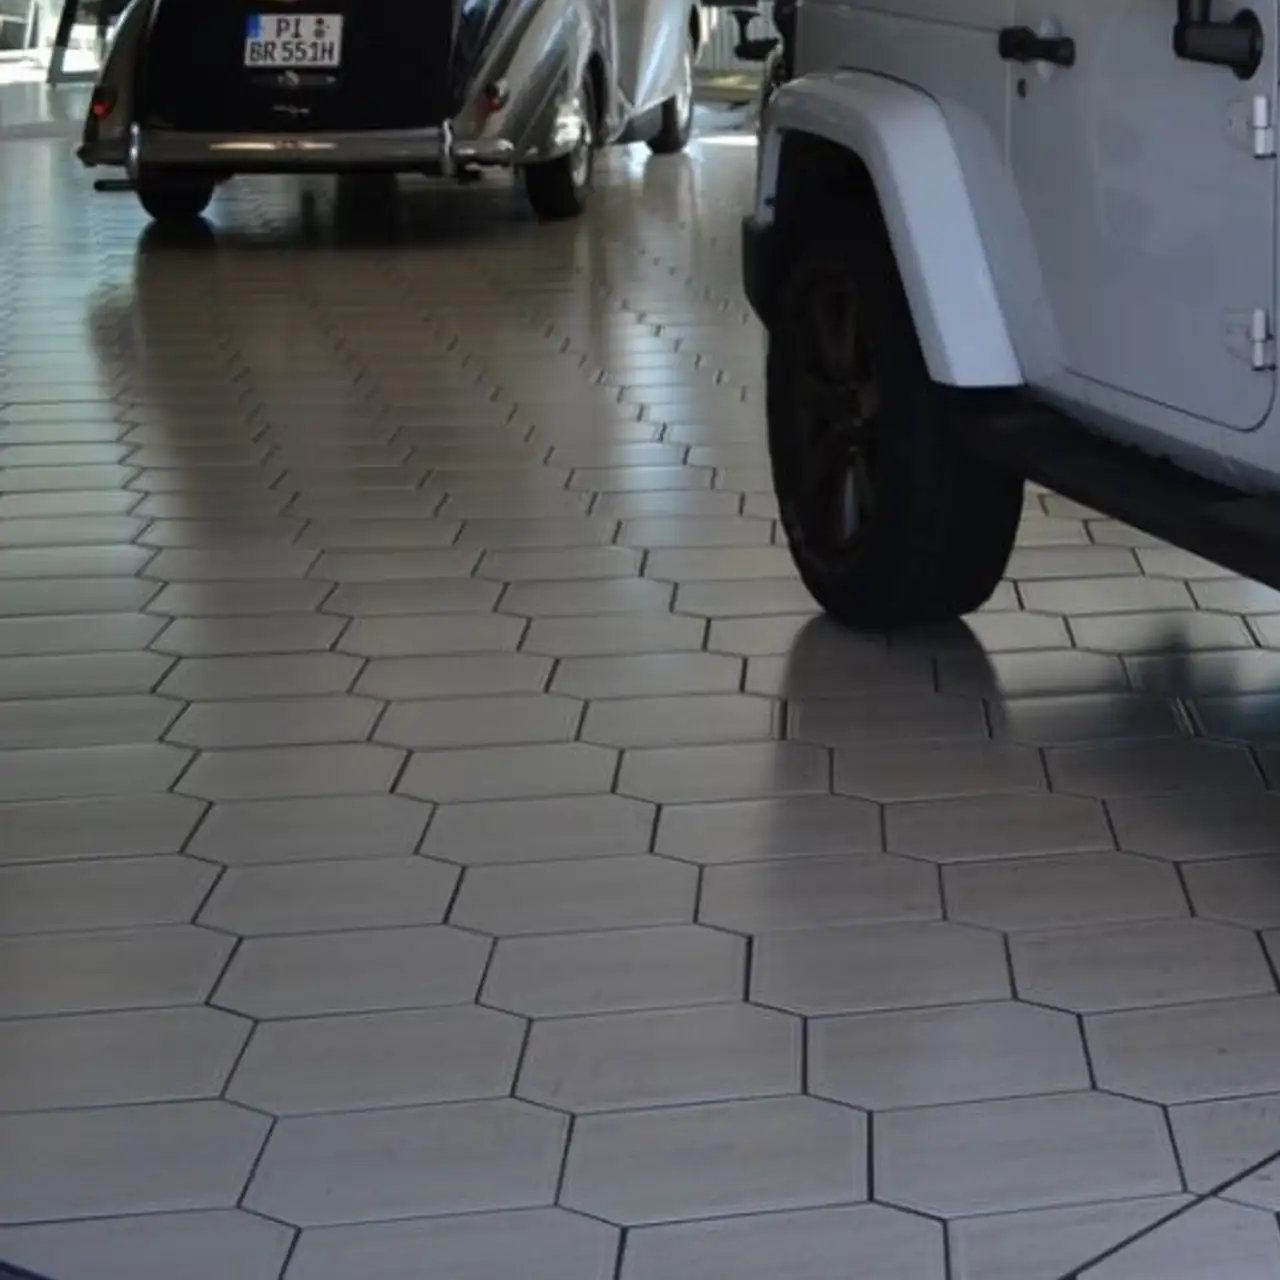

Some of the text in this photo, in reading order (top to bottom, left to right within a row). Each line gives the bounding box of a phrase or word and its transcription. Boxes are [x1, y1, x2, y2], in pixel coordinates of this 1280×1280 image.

[275, 18, 302, 38] PI
[250, 42, 335, 62] BR 551H
